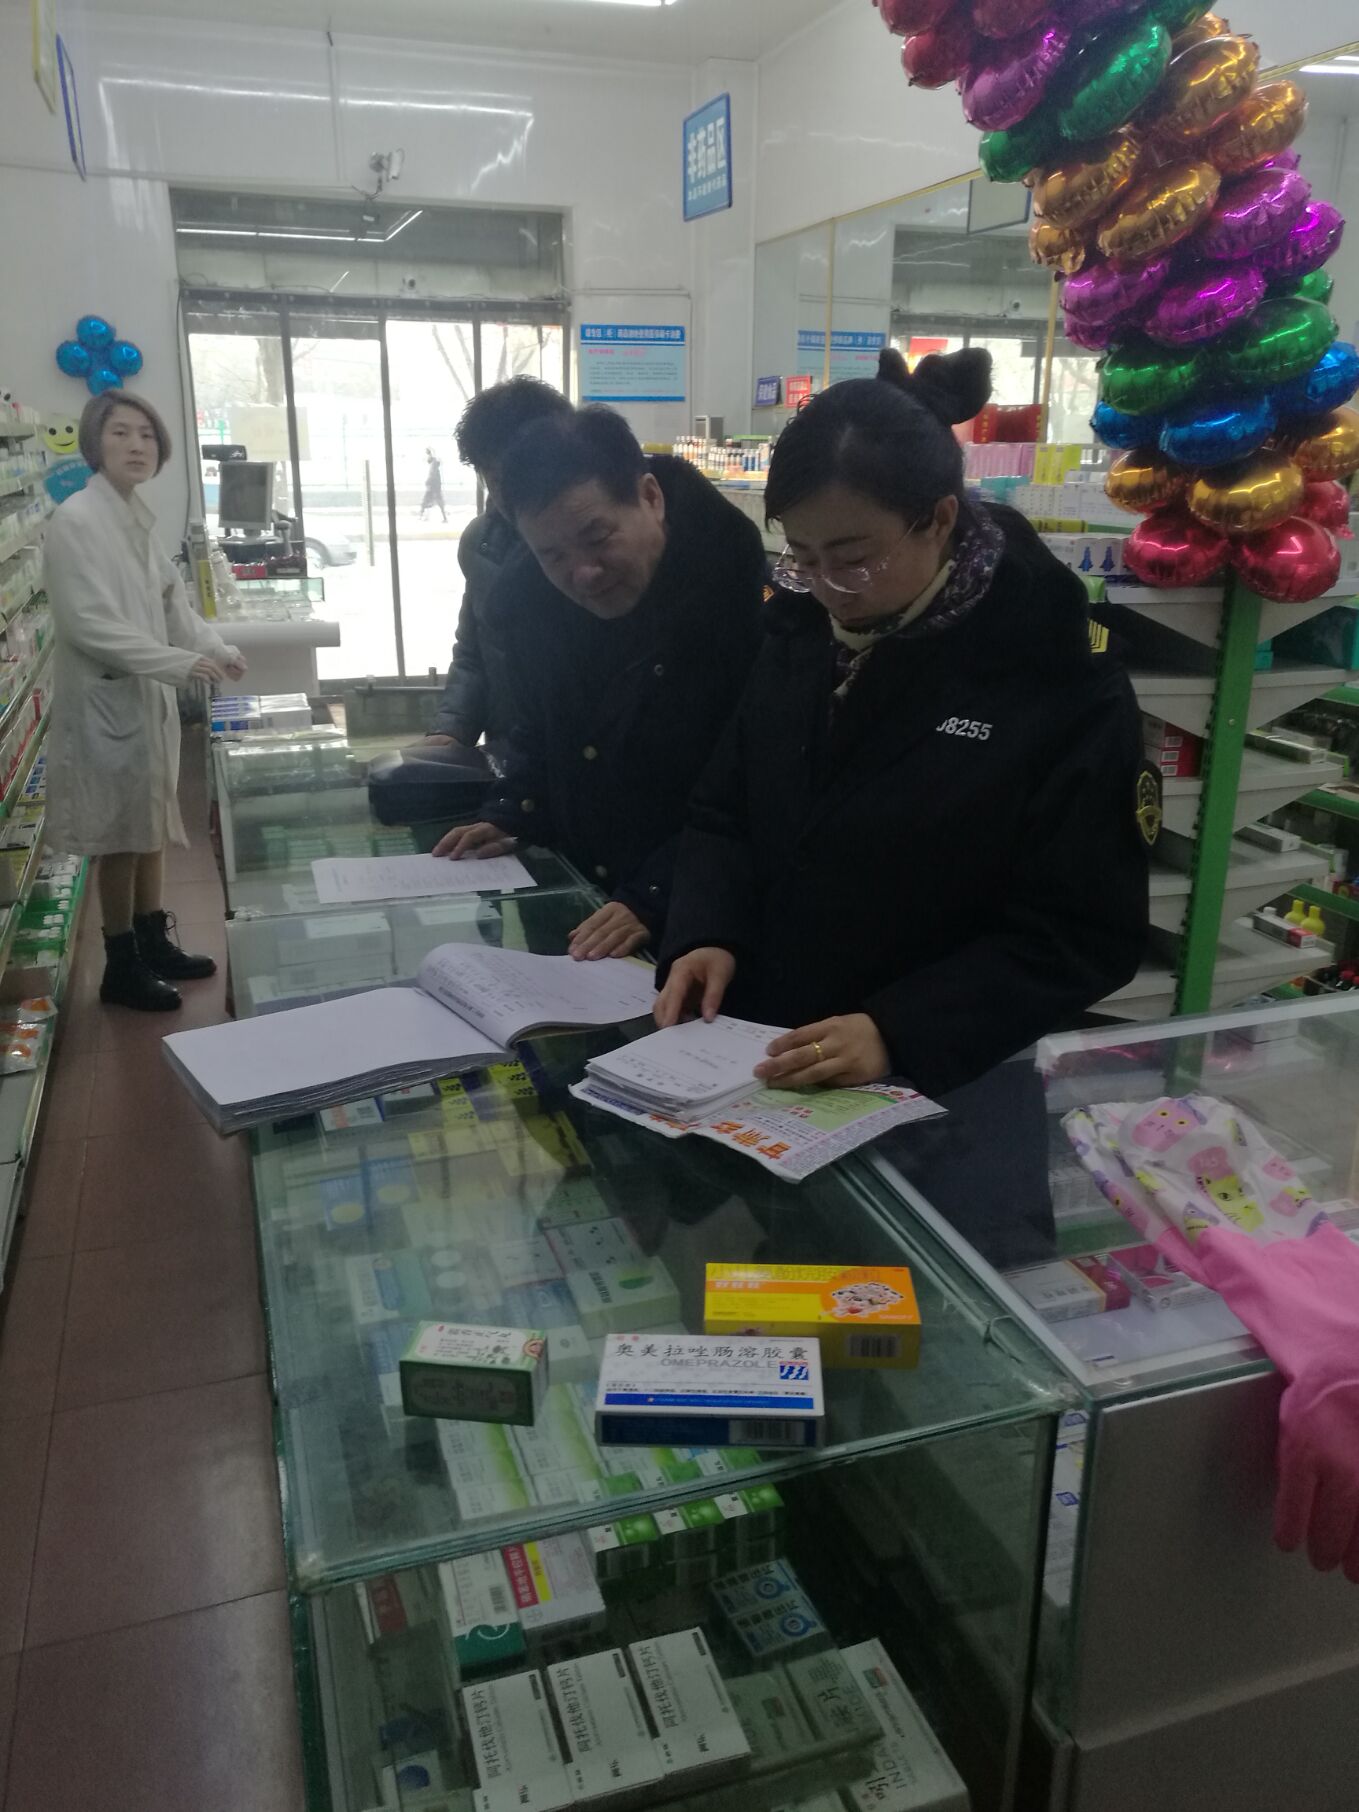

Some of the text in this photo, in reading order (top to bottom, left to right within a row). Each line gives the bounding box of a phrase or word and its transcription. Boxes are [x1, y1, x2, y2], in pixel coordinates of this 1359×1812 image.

[688, 116, 727, 184] 非药品区
[615, 1343, 809, 1361] 奥美拉唑肠溶胶囊
[660, 1357, 777, 1369] OMEPRAZOLE
[556, 1667, 593, 1752] 阿托伐他汀钙片
[640, 1645, 679, 1729] 阿托伐他汀钙片
[471, 1689, 501, 1779] 阿托伐他汀钙片
